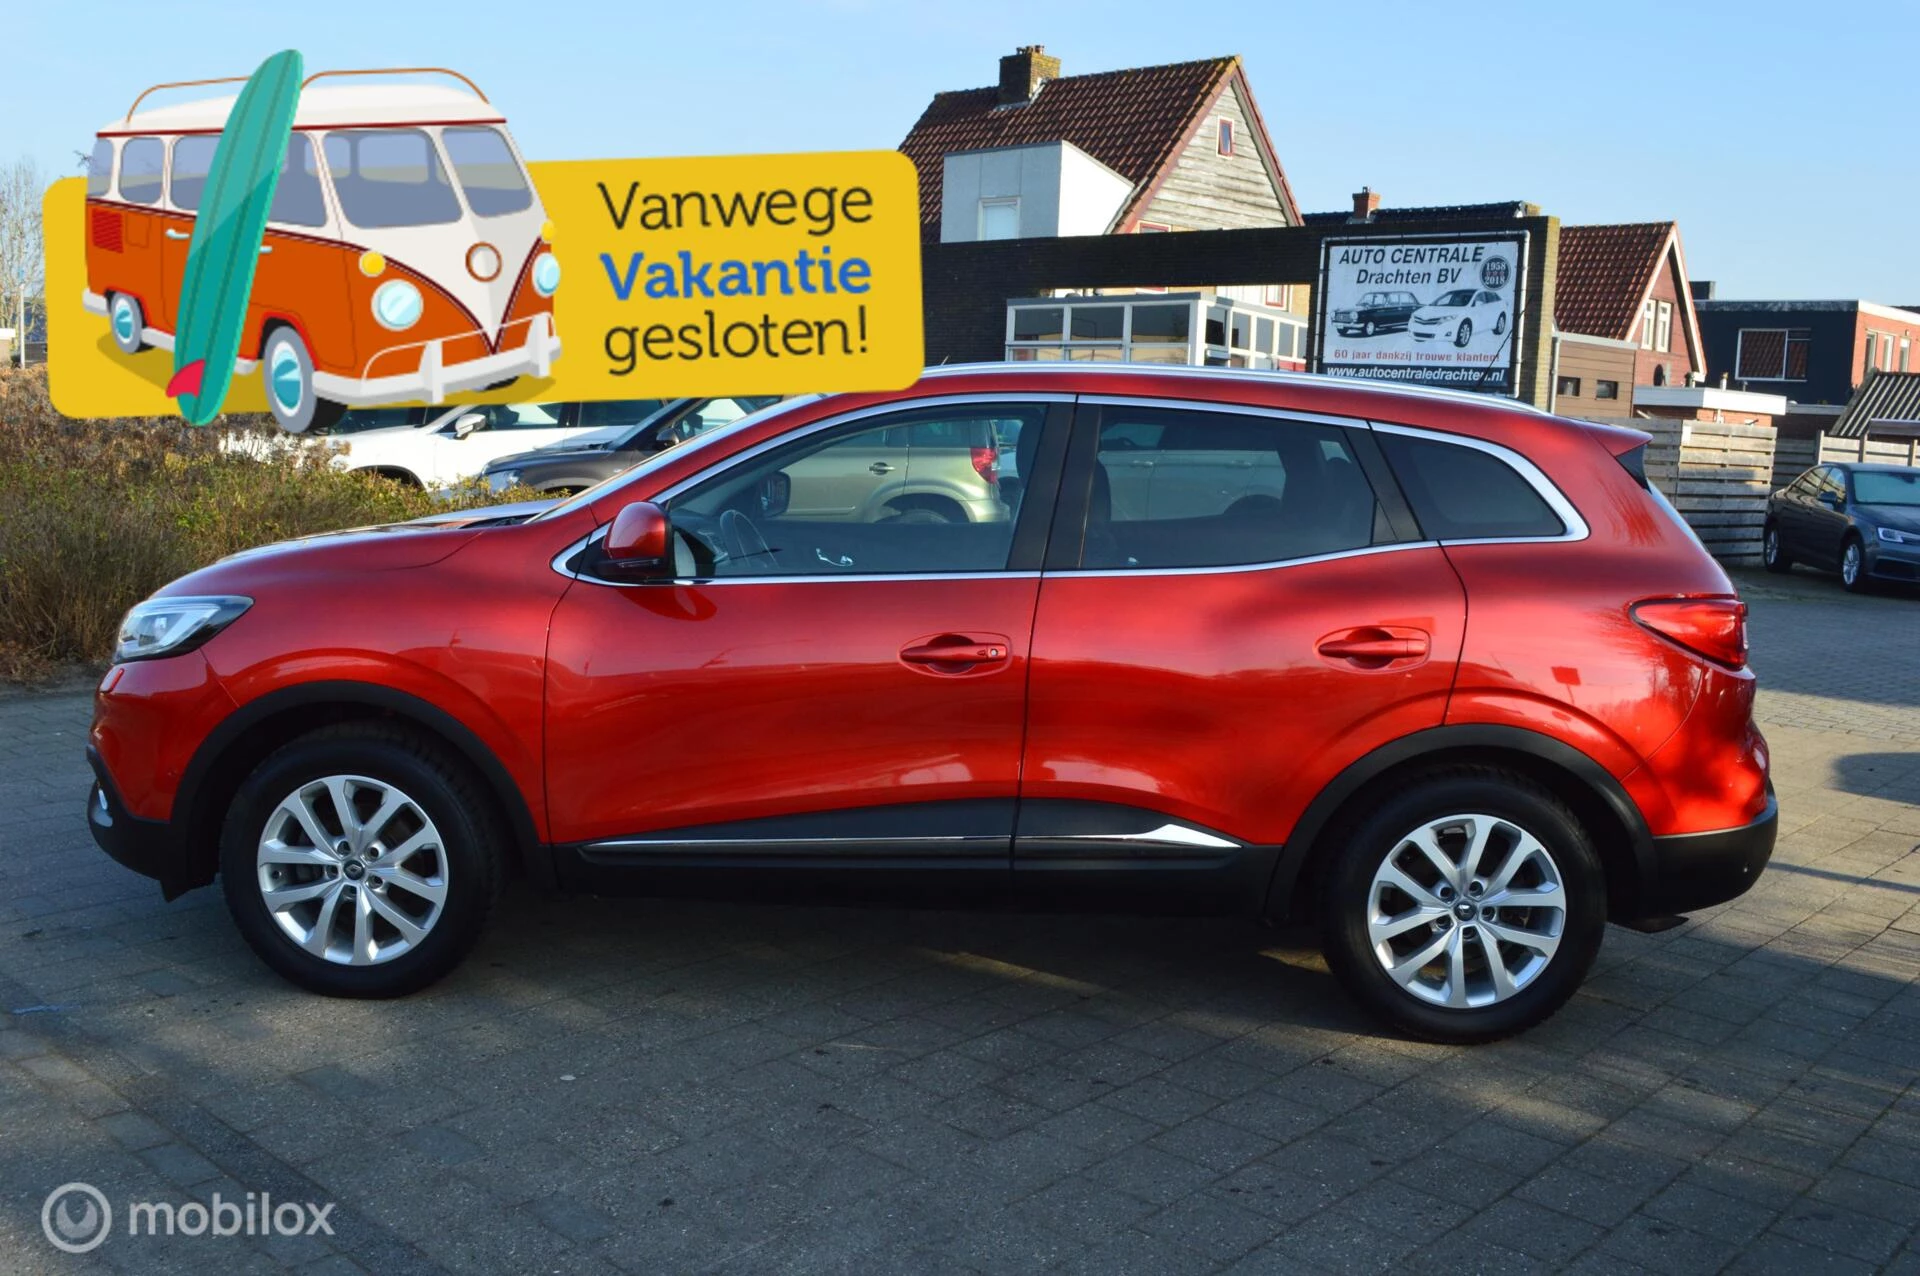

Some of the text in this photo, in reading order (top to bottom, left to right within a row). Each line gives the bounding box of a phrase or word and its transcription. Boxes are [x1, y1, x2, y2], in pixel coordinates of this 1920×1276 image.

[1339, 246, 1485, 265] AUTO CENTRALE
[1486, 261, 1506, 271] 1958
[1356, 268, 1463, 284] Drachten BV
[1484, 275, 1505, 285] 2018
[1334, 349, 1348, 359] 60
[1352, 350, 1372, 361] jaar
[1376, 350, 1412, 362] dankzij
[1416, 351, 1452, 361] trouwe
